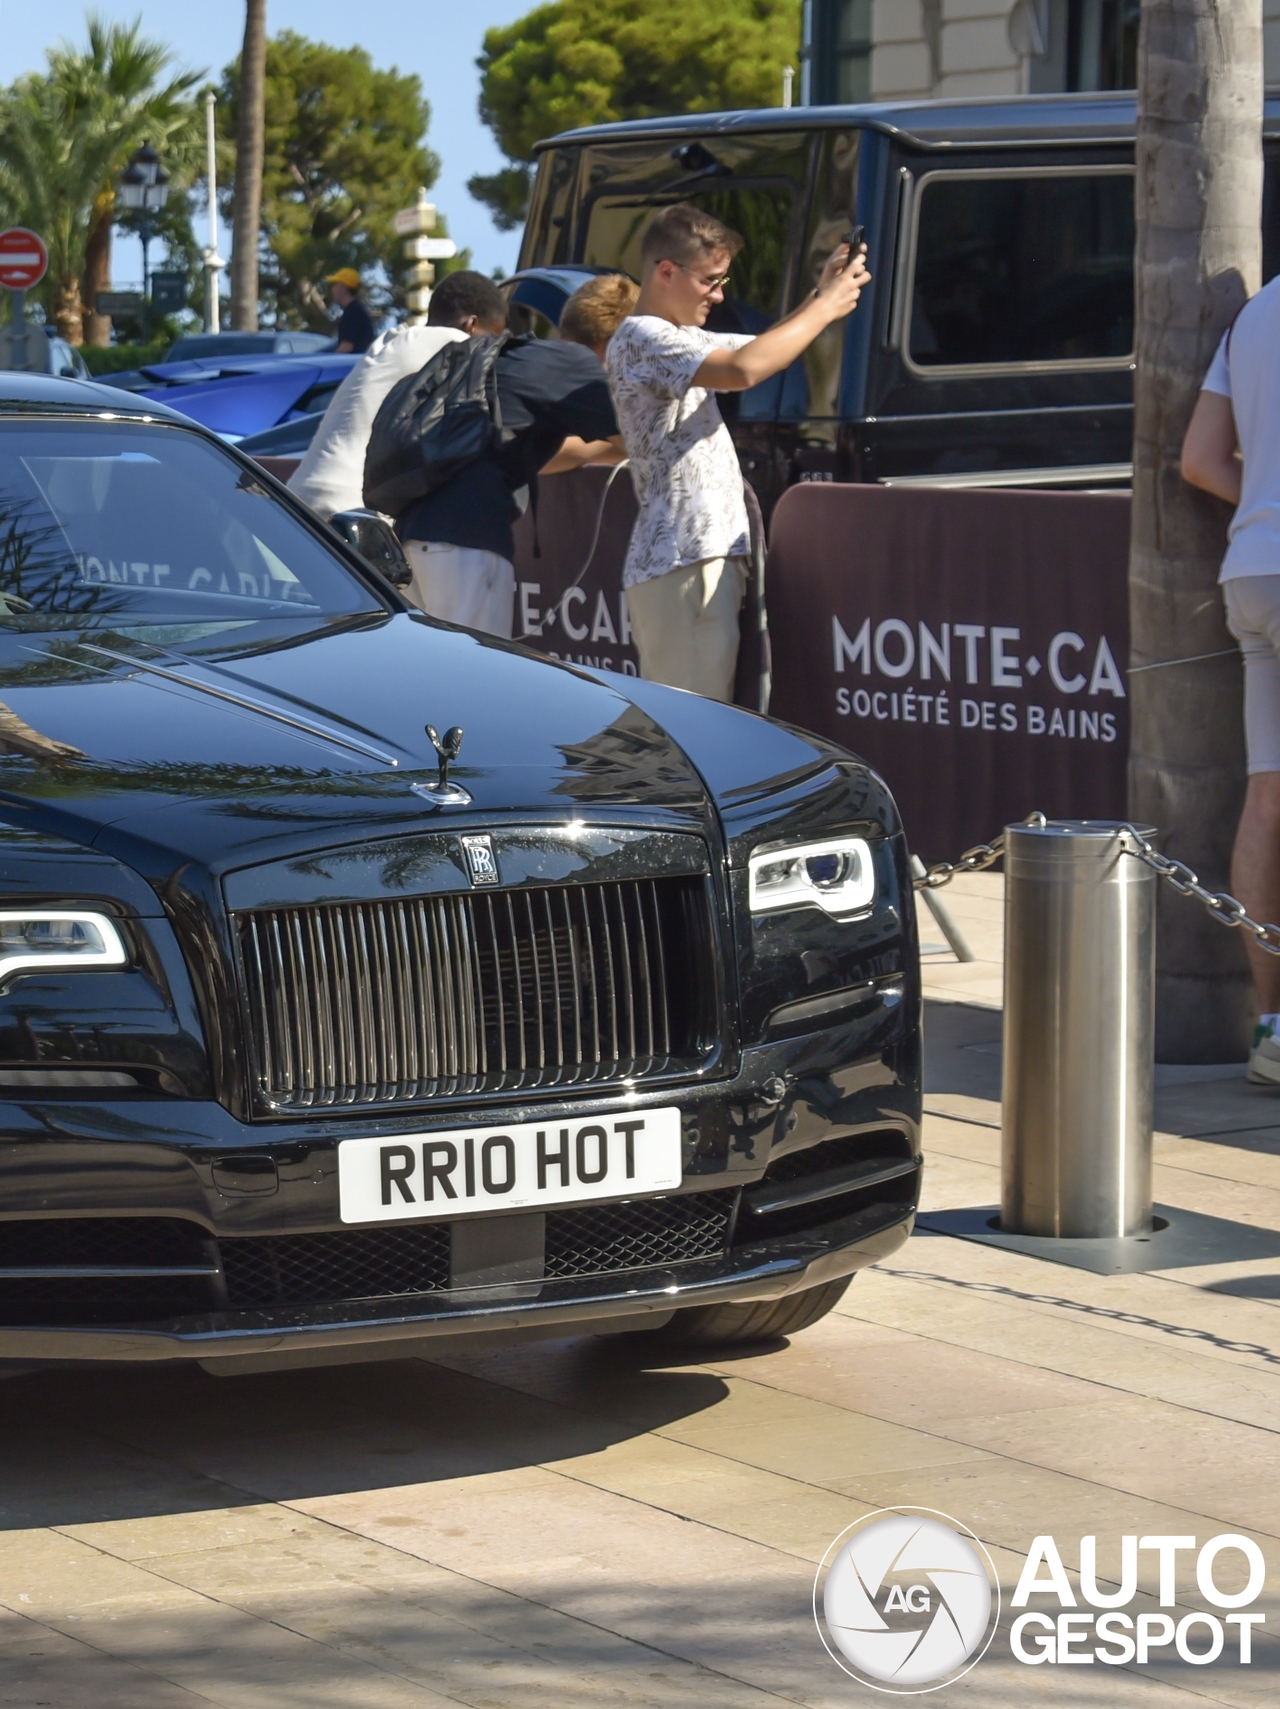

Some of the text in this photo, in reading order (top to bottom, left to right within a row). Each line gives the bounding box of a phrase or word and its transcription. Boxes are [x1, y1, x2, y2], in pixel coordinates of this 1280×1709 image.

[835, 686, 1117, 743] SOCIÉTÉ DES BAINS
[535, 1119, 646, 1190] HOT
